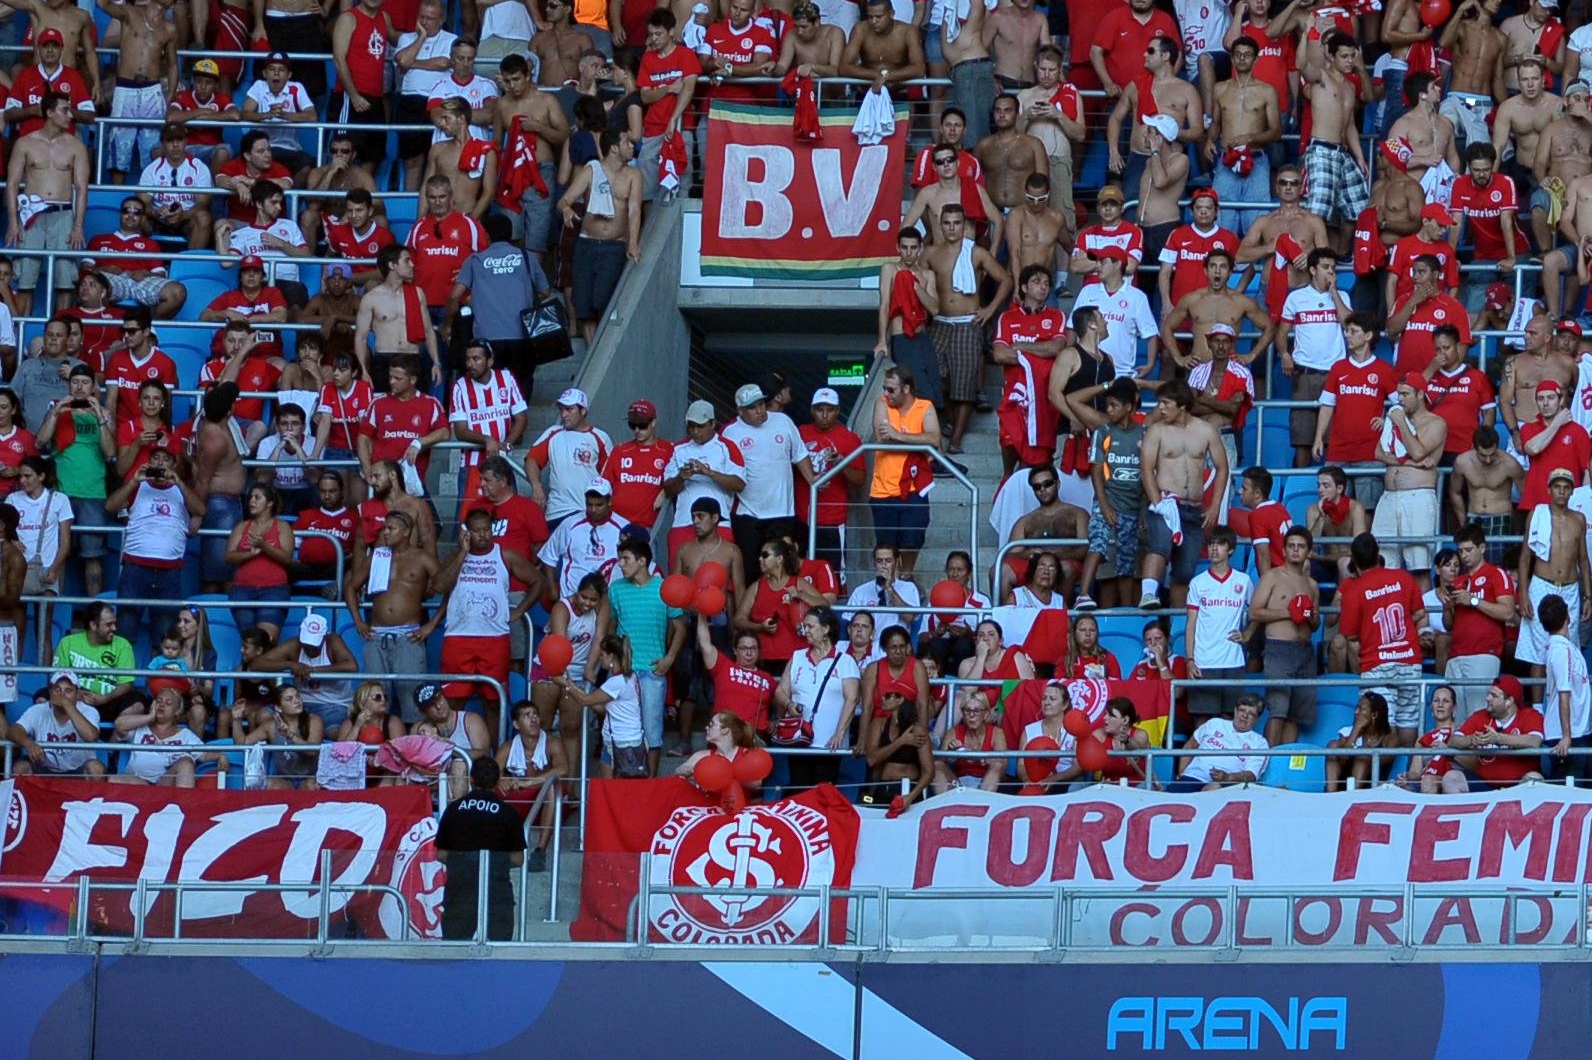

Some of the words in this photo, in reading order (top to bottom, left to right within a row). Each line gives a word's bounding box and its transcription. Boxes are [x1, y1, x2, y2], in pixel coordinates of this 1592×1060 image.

[1258, 47, 1282, 57] risul
[718, 142, 892, 239] B.V.
[493, 267, 514, 276] zero
[1103, 312, 1126, 323] risul
[1340, 385, 1378, 397] Banrisul
[469, 409, 512, 422] Banrisul
[620, 457, 632, 470] 10
[1108, 453, 1140, 465] Banris
[621, 473, 661, 485] Banrisul
[1365, 585, 1401, 600] Banrisul
[1201, 597, 1242, 608] Banrisul
[1372, 604, 1407, 644] 10
[1378, 649, 1414, 661] Unimed
[457, 799, 500, 813] APOIO
[912, 800, 1254, 890] FORÇA
[42, 797, 387, 920] FICO
[1106, 997, 1347, 1050] ARENA
